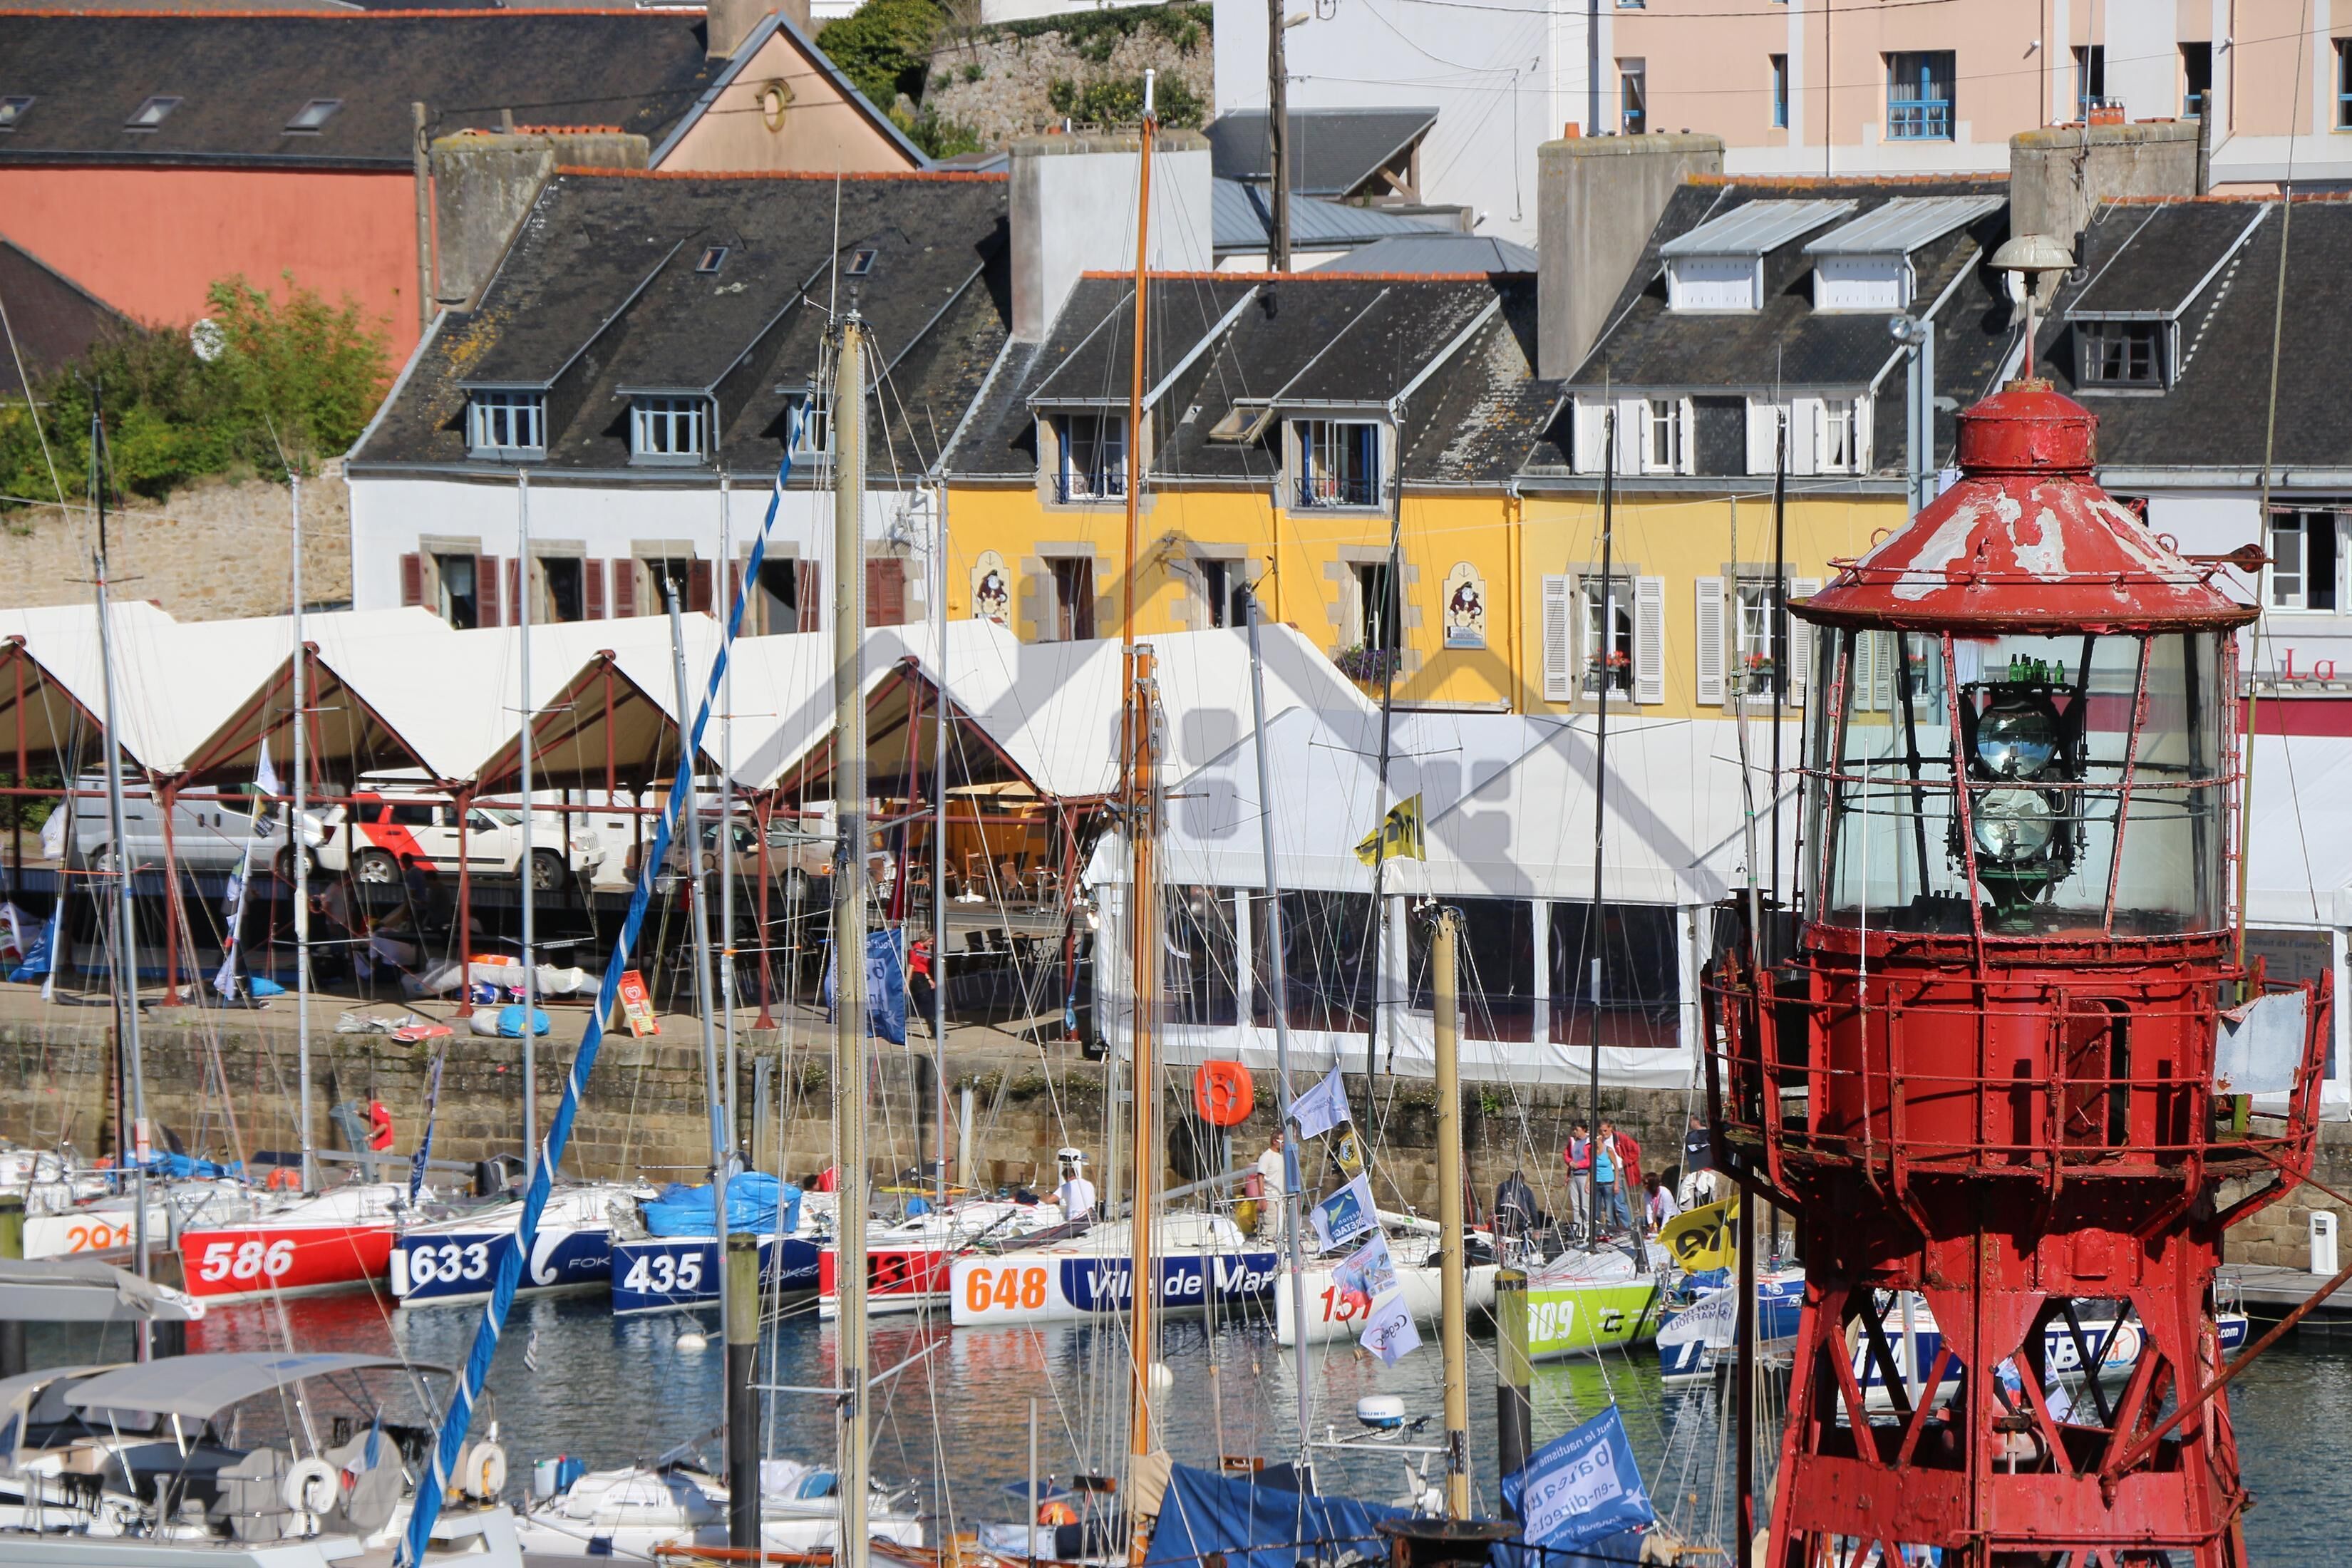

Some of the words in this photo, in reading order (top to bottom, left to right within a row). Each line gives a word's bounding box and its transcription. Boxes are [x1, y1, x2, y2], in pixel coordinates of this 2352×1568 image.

[2283, 648, 2337, 681] La
[200, 1239, 295, 1282] 586
[410, 1243, 489, 1283] 633
[624, 1252, 703, 1294] 435
[966, 1267, 1047, 1312] 648
[1164, 1268, 1202, 1296] de
[1321, 1285, 1373, 1322] 151
